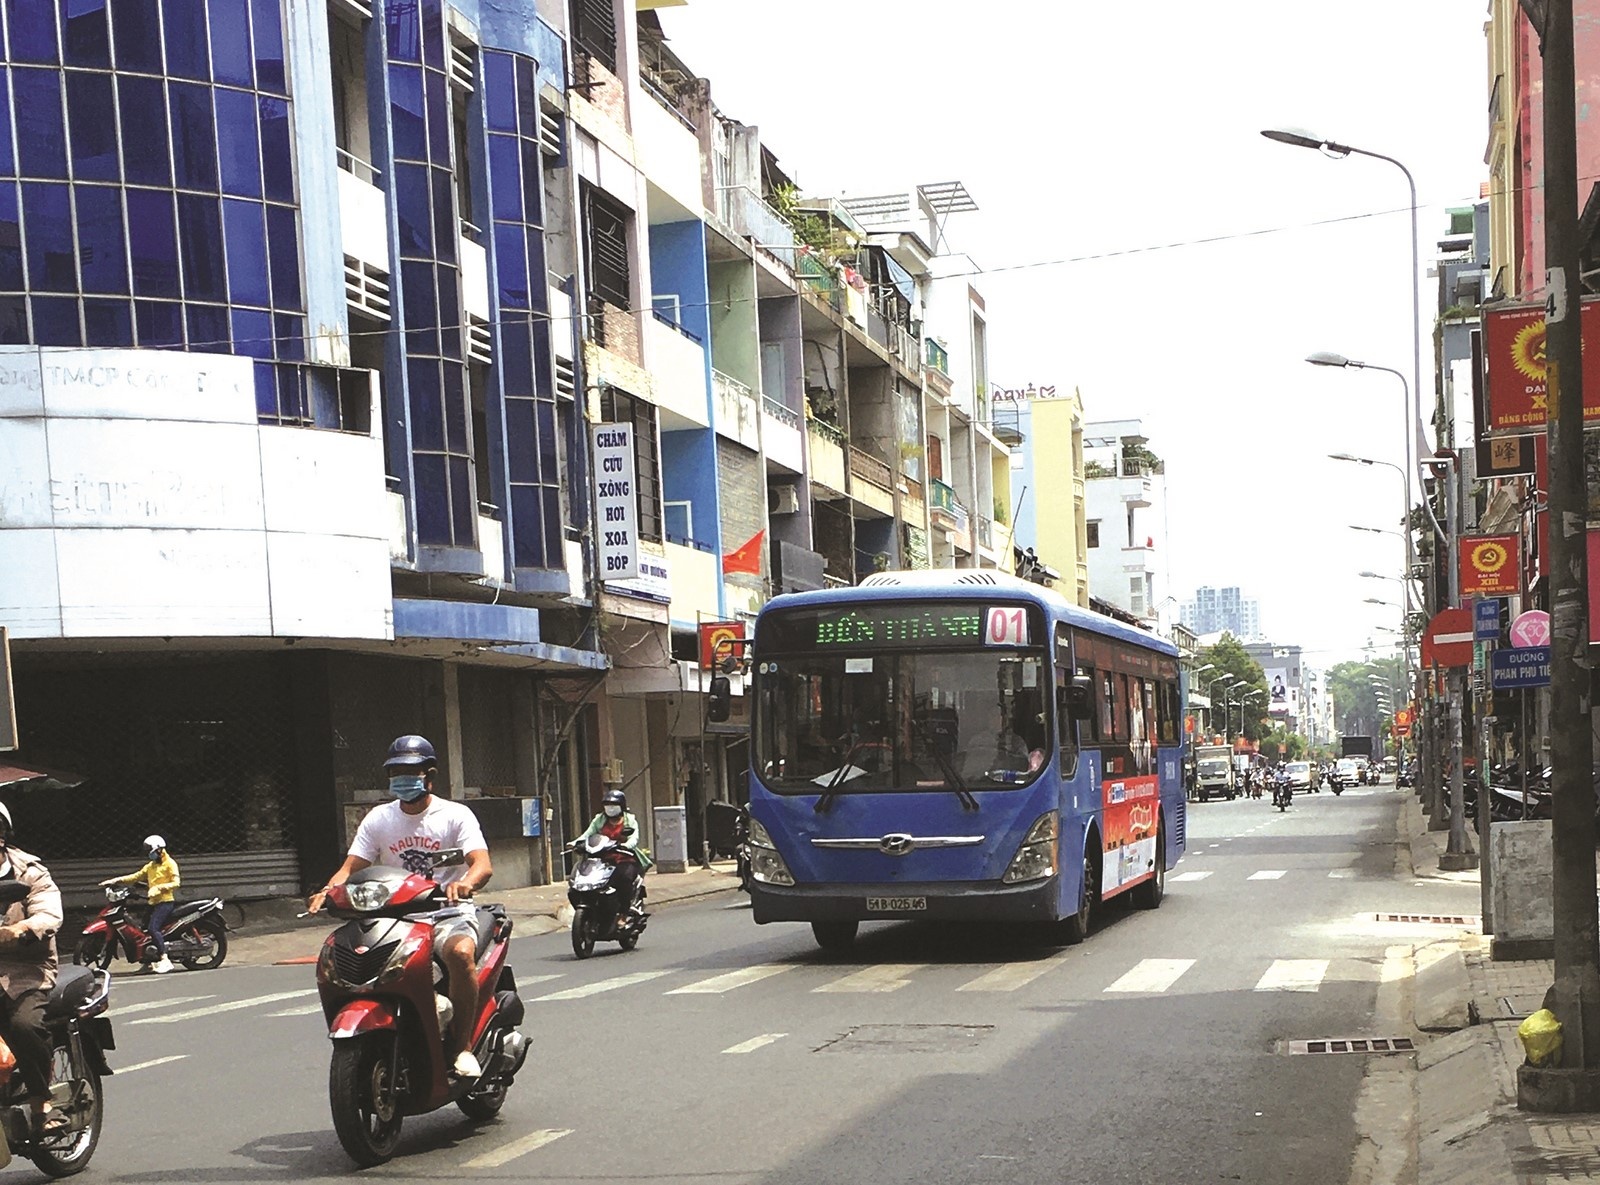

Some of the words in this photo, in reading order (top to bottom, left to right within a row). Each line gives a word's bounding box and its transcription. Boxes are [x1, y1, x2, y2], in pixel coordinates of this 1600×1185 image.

[1545, 293, 1557, 317] 4
[597, 429, 627, 448] CHÂM
[603, 454, 623, 473] CỨU
[599, 478, 629, 498] XÔNG
[605, 531, 629, 547] XOA
[606, 552, 629, 571] BÓP
[990, 609, 1024, 644] 01
[1509, 651, 1545, 664] ĐƯỜNG
[1494, 667, 1517, 680] PHAN
[389, 836, 441, 855] NAUTICA
